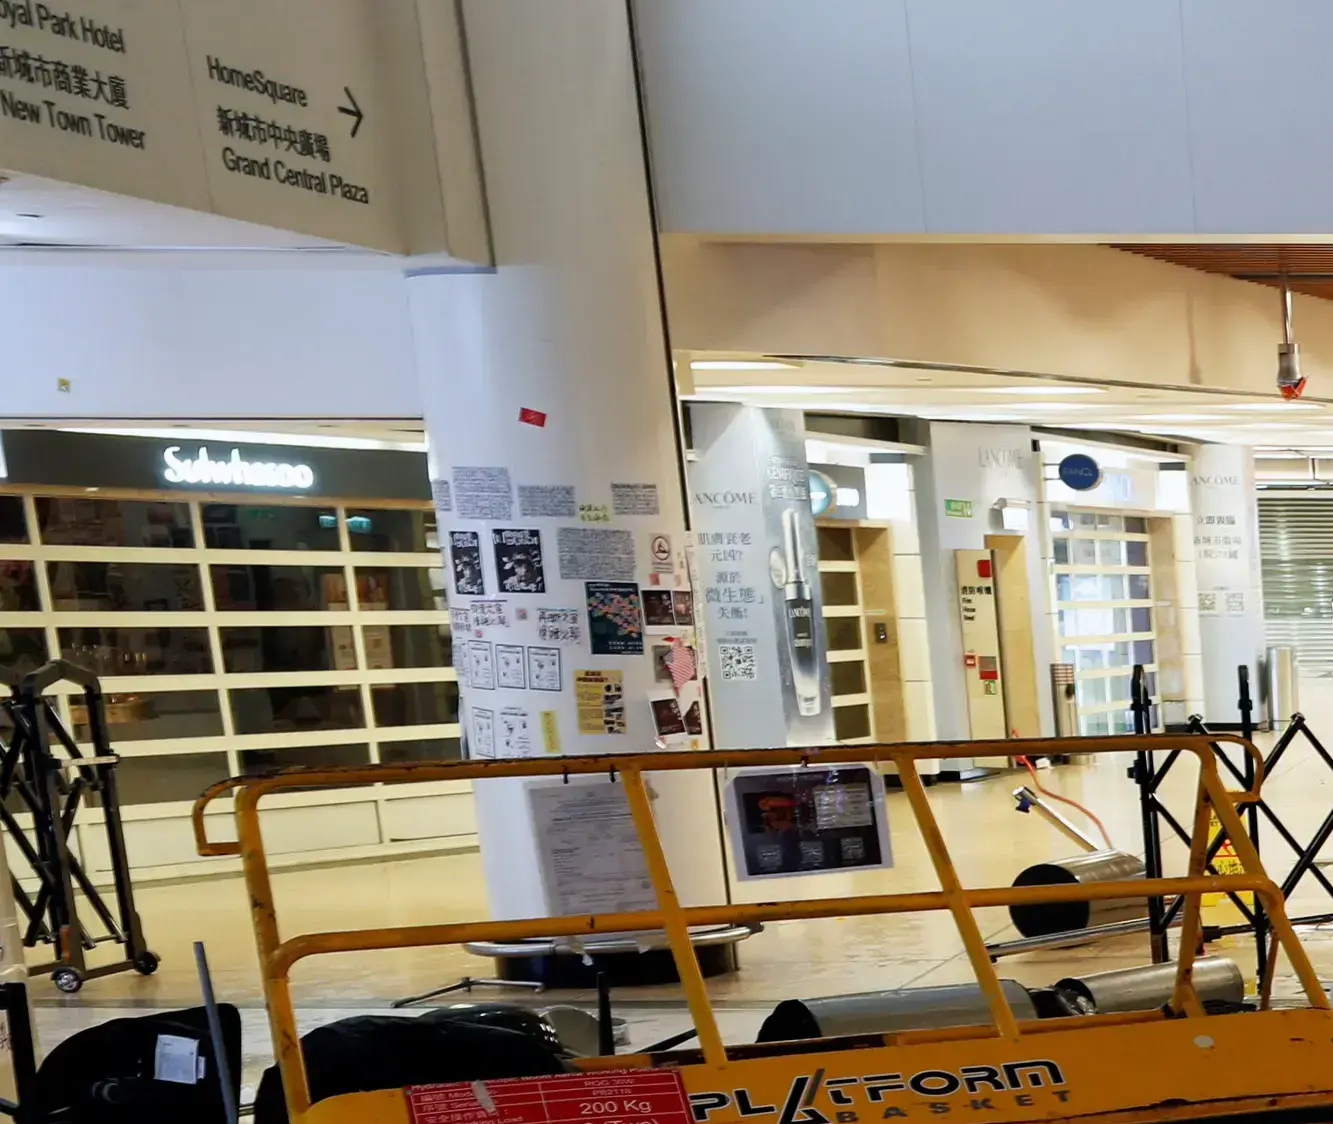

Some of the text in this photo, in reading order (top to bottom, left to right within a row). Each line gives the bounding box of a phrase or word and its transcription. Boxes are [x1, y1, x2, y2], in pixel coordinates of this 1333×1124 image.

[0, 0, 126, 54] oyal Park Hotel
[206, 55, 308, 107] HomeSquare
[1, 90, 147, 150] New Town Tower
[217, 105, 331, 163] 新城市中央廣場
[222, 147, 369, 204] Grand Central Plaza
[692, 489, 757, 505] ANCÔME
[579, 1099, 652, 1115] 200 Kg
[835, 1089, 1072, 1124] BASKET
